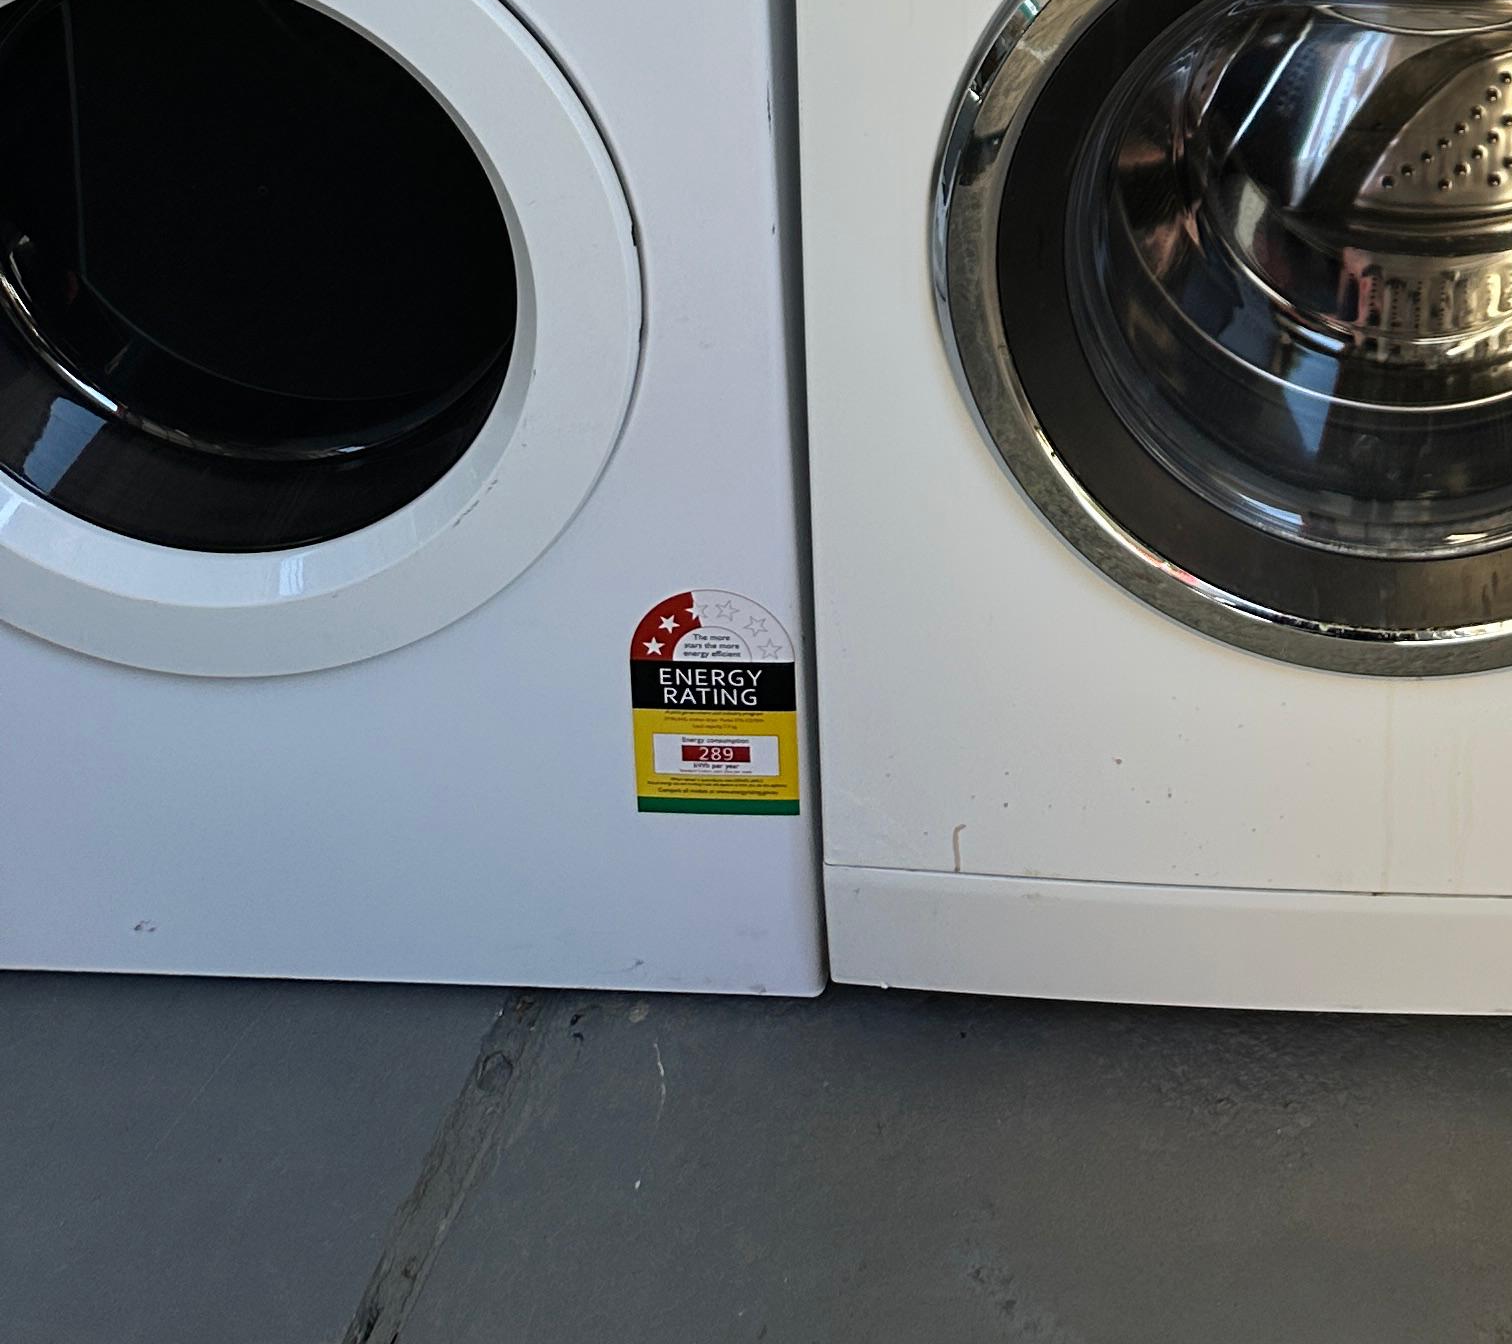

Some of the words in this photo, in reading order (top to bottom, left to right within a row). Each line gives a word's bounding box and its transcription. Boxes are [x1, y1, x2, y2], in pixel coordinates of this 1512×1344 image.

[659, 669, 762, 686] ENERGY
[664, 688, 757, 705] RATING
[699, 748, 733, 761] 289
